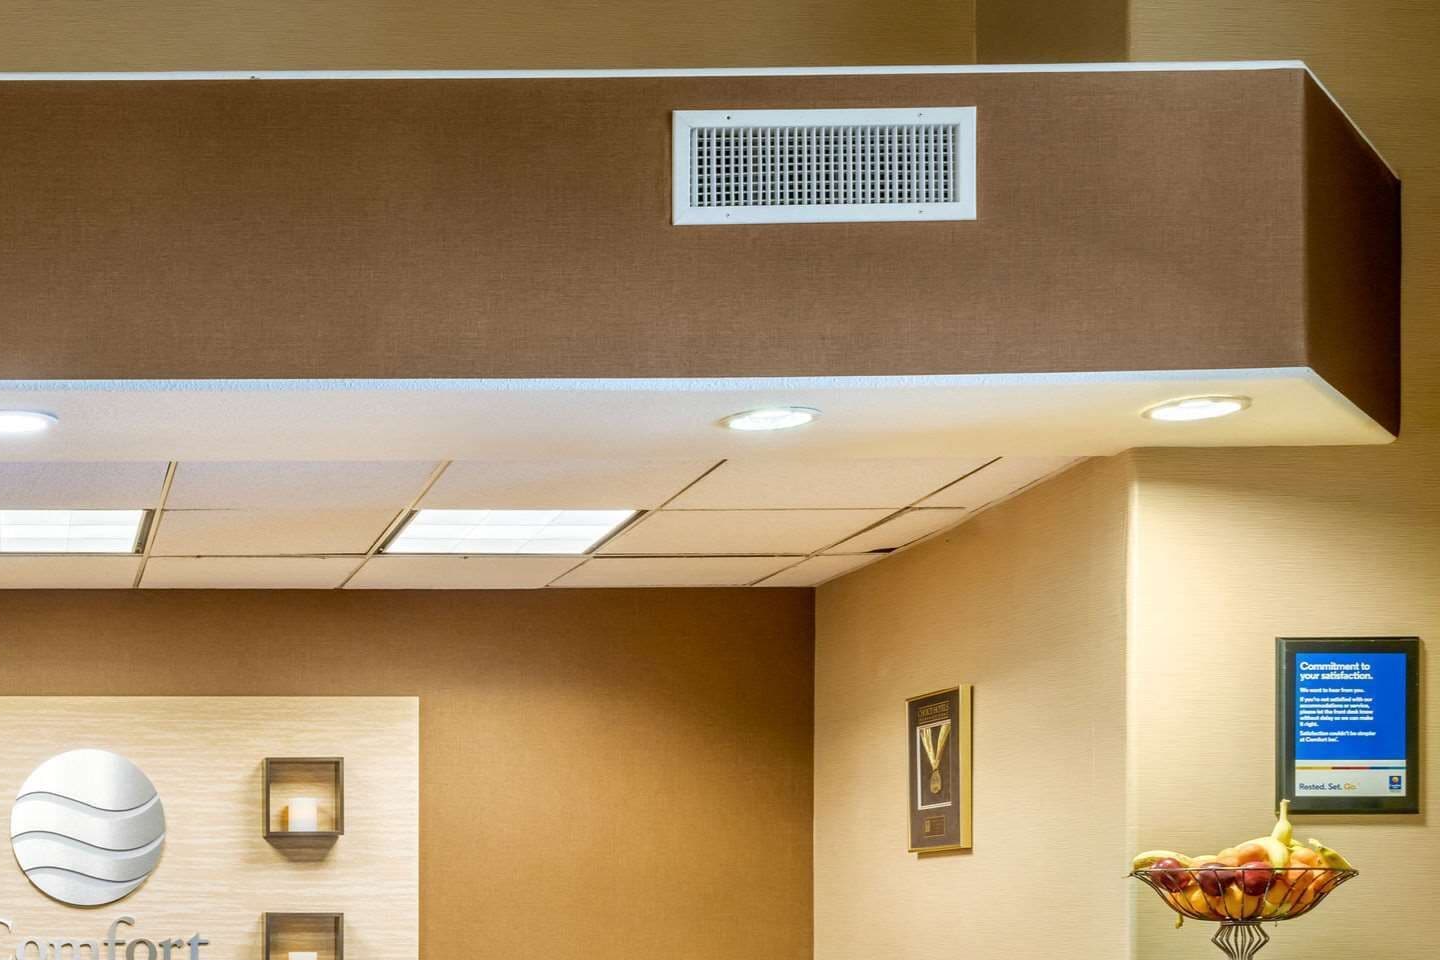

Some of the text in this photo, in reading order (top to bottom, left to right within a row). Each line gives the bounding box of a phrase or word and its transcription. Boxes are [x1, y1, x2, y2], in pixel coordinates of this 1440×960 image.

[1300, 661, 1371, 671] Commitment to
[1300, 671, 1373, 681] your satisfaction.
[1299, 782, 1326, 790] Rested.
[1328, 782, 1342, 790] Set.
